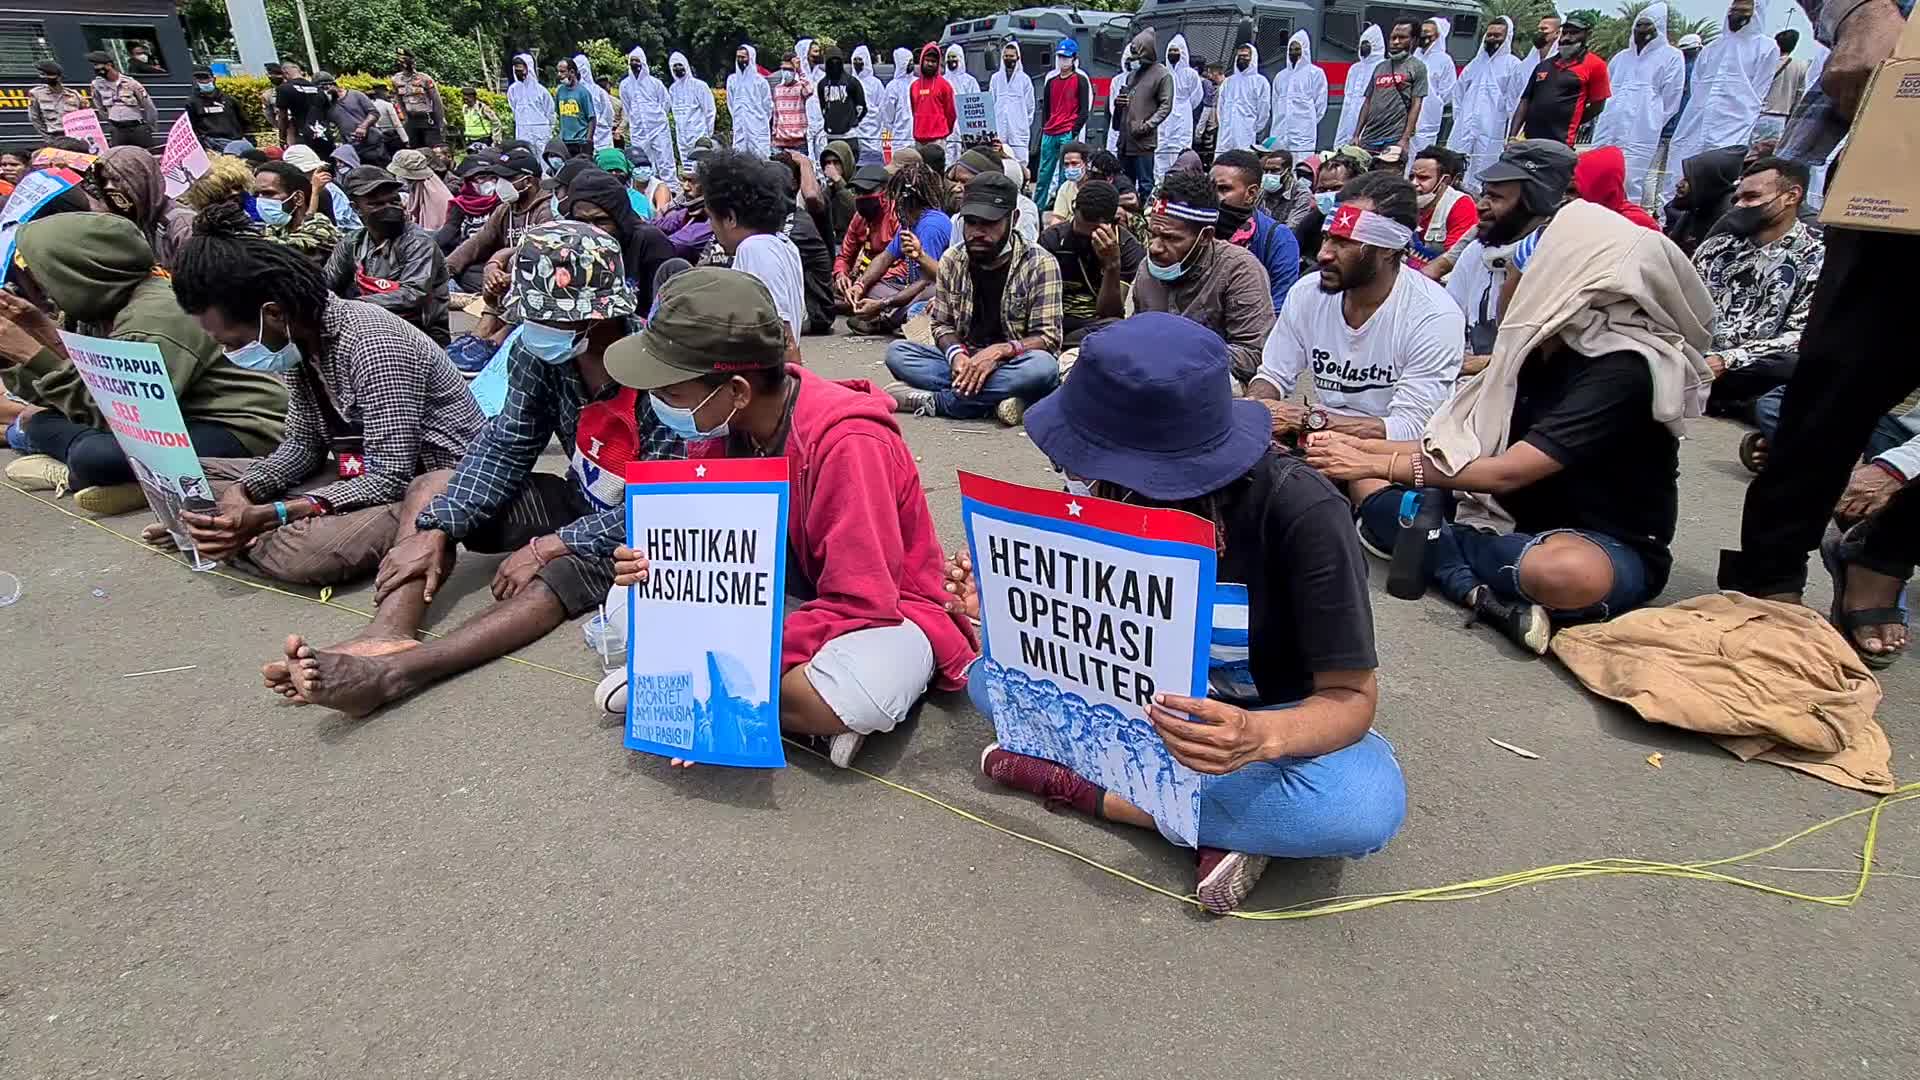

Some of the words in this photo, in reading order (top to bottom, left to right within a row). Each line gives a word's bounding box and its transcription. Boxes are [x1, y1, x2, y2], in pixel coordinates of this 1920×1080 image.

[966, 120, 987, 128] NKRI
[86, 352, 114, 370] WEST
[115, 357, 163, 375] PAPUA
[1312, 348, 1398, 383] Soelastri
[101, 375, 138, 398] RIGHT
[140, 382, 165, 400] TO
[111, 400, 141, 424] SELF
[647, 528, 757, 564] HENTIKAN
[639, 567, 768, 606] RASIALISME
[988, 535, 1174, 620] HENTIKAN
[1007, 586, 1153, 668] OPERASI
[1019, 630, 1156, 707] MILITER
[657, 675, 689, 690] BUKAN
[636, 688, 684, 706] MONYET
[654, 705, 693, 722] MANUSIA
